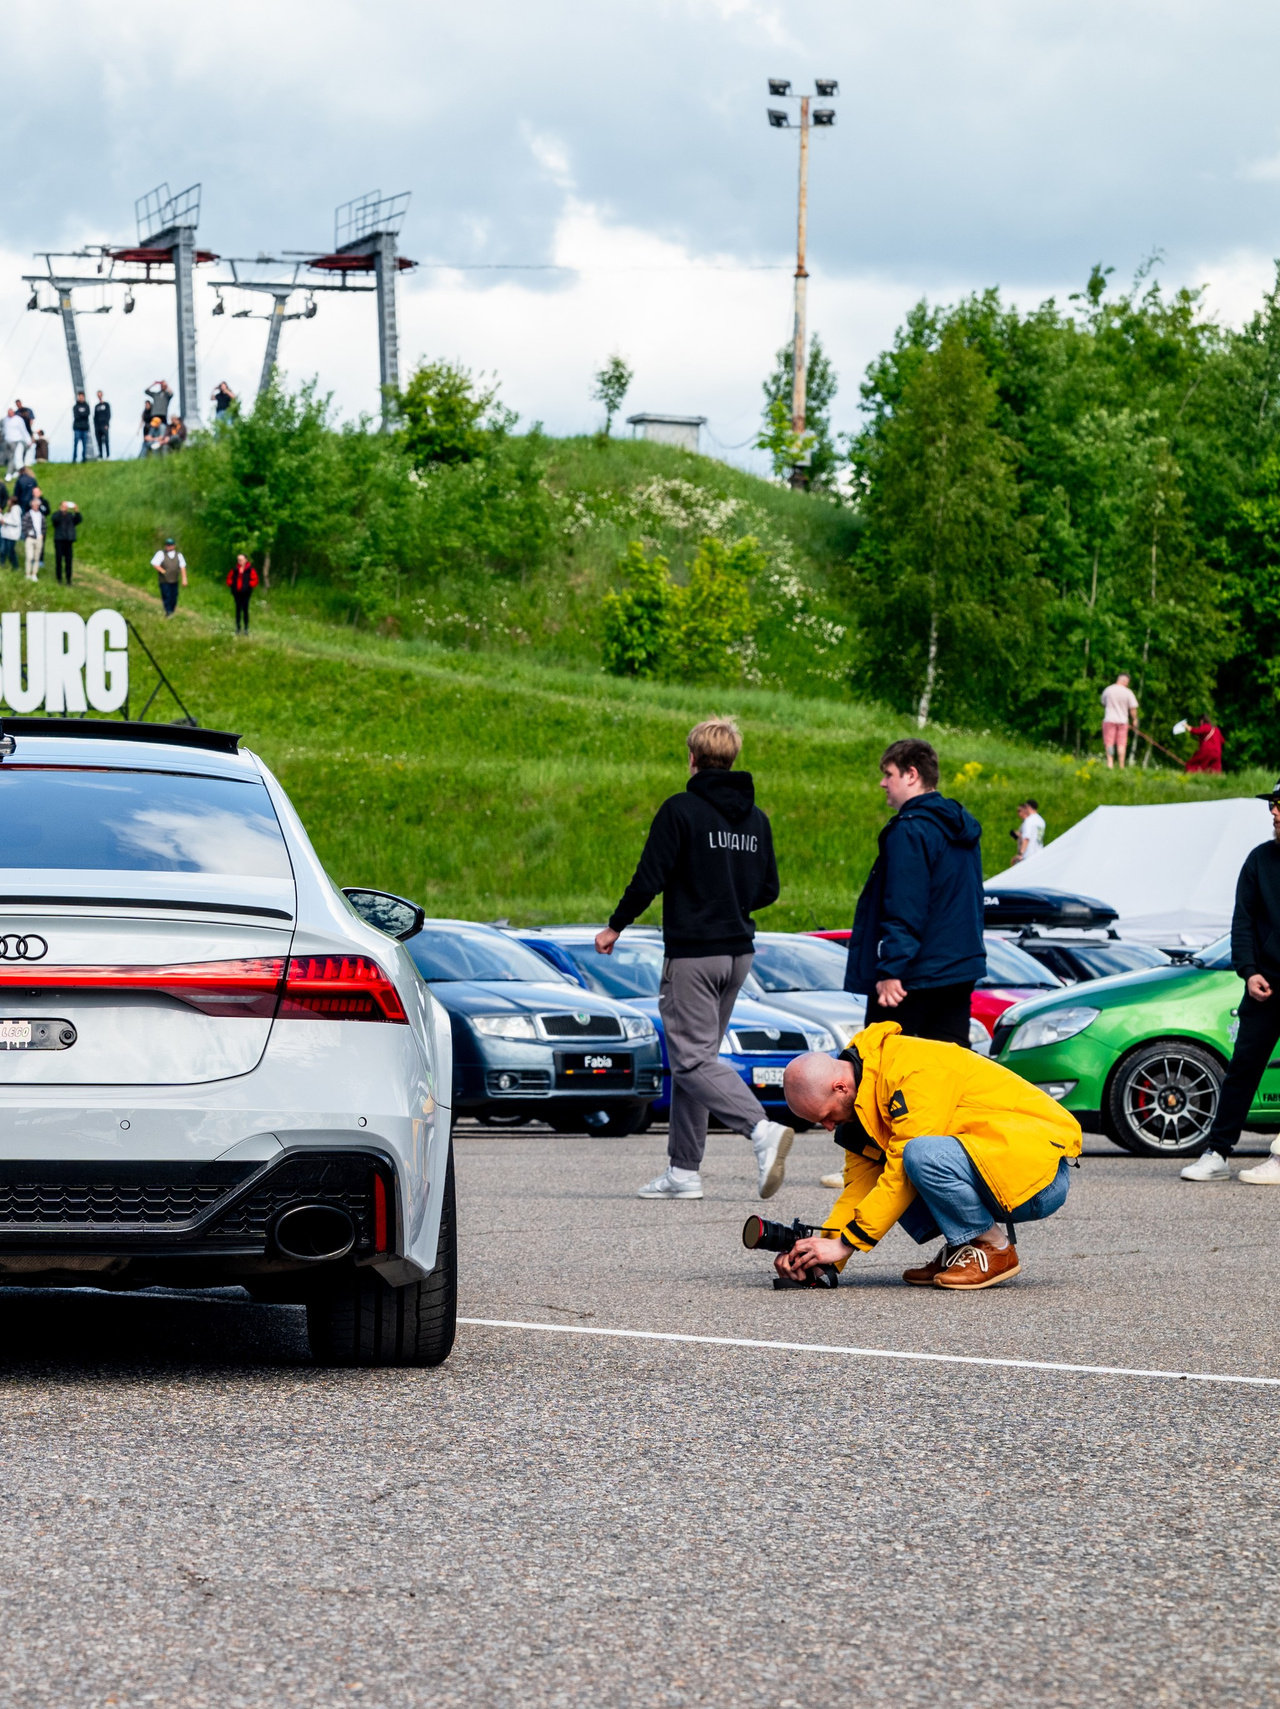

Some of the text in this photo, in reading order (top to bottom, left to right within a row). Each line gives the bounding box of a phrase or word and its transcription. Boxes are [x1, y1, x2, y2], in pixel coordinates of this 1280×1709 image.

[1, 1026, 30, 1038] LEGO
[584, 1055, 613, 1068] Fabia
[757, 1070, 784, 1082] H032
